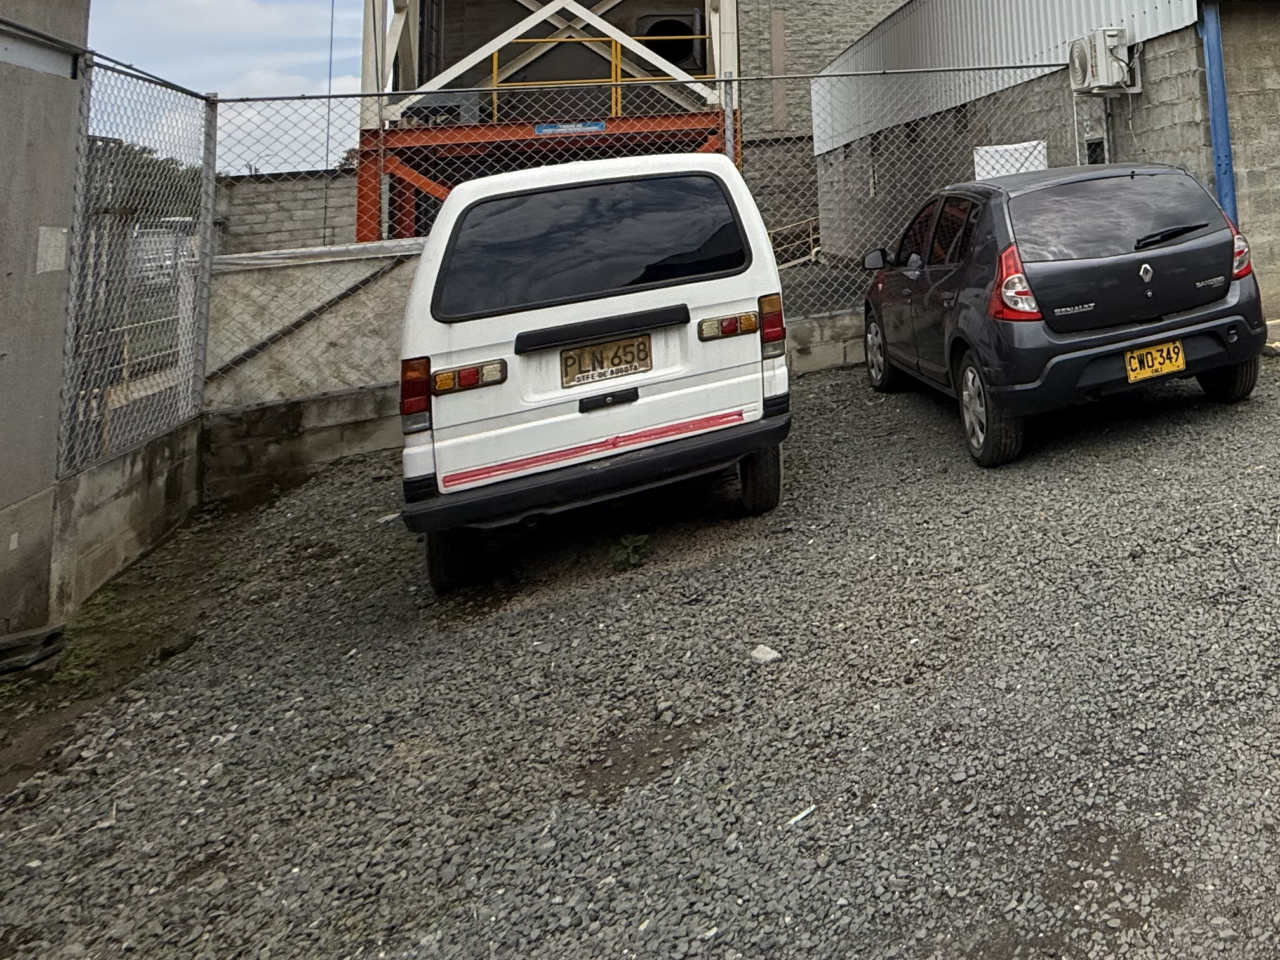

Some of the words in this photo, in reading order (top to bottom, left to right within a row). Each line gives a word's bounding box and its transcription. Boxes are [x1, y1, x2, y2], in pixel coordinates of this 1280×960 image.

[1054, 302, 1096, 316] RENAULT
[564, 349, 605, 378] PLN
[610, 342, 649, 366] 658
[597, 370, 608, 378] DE
